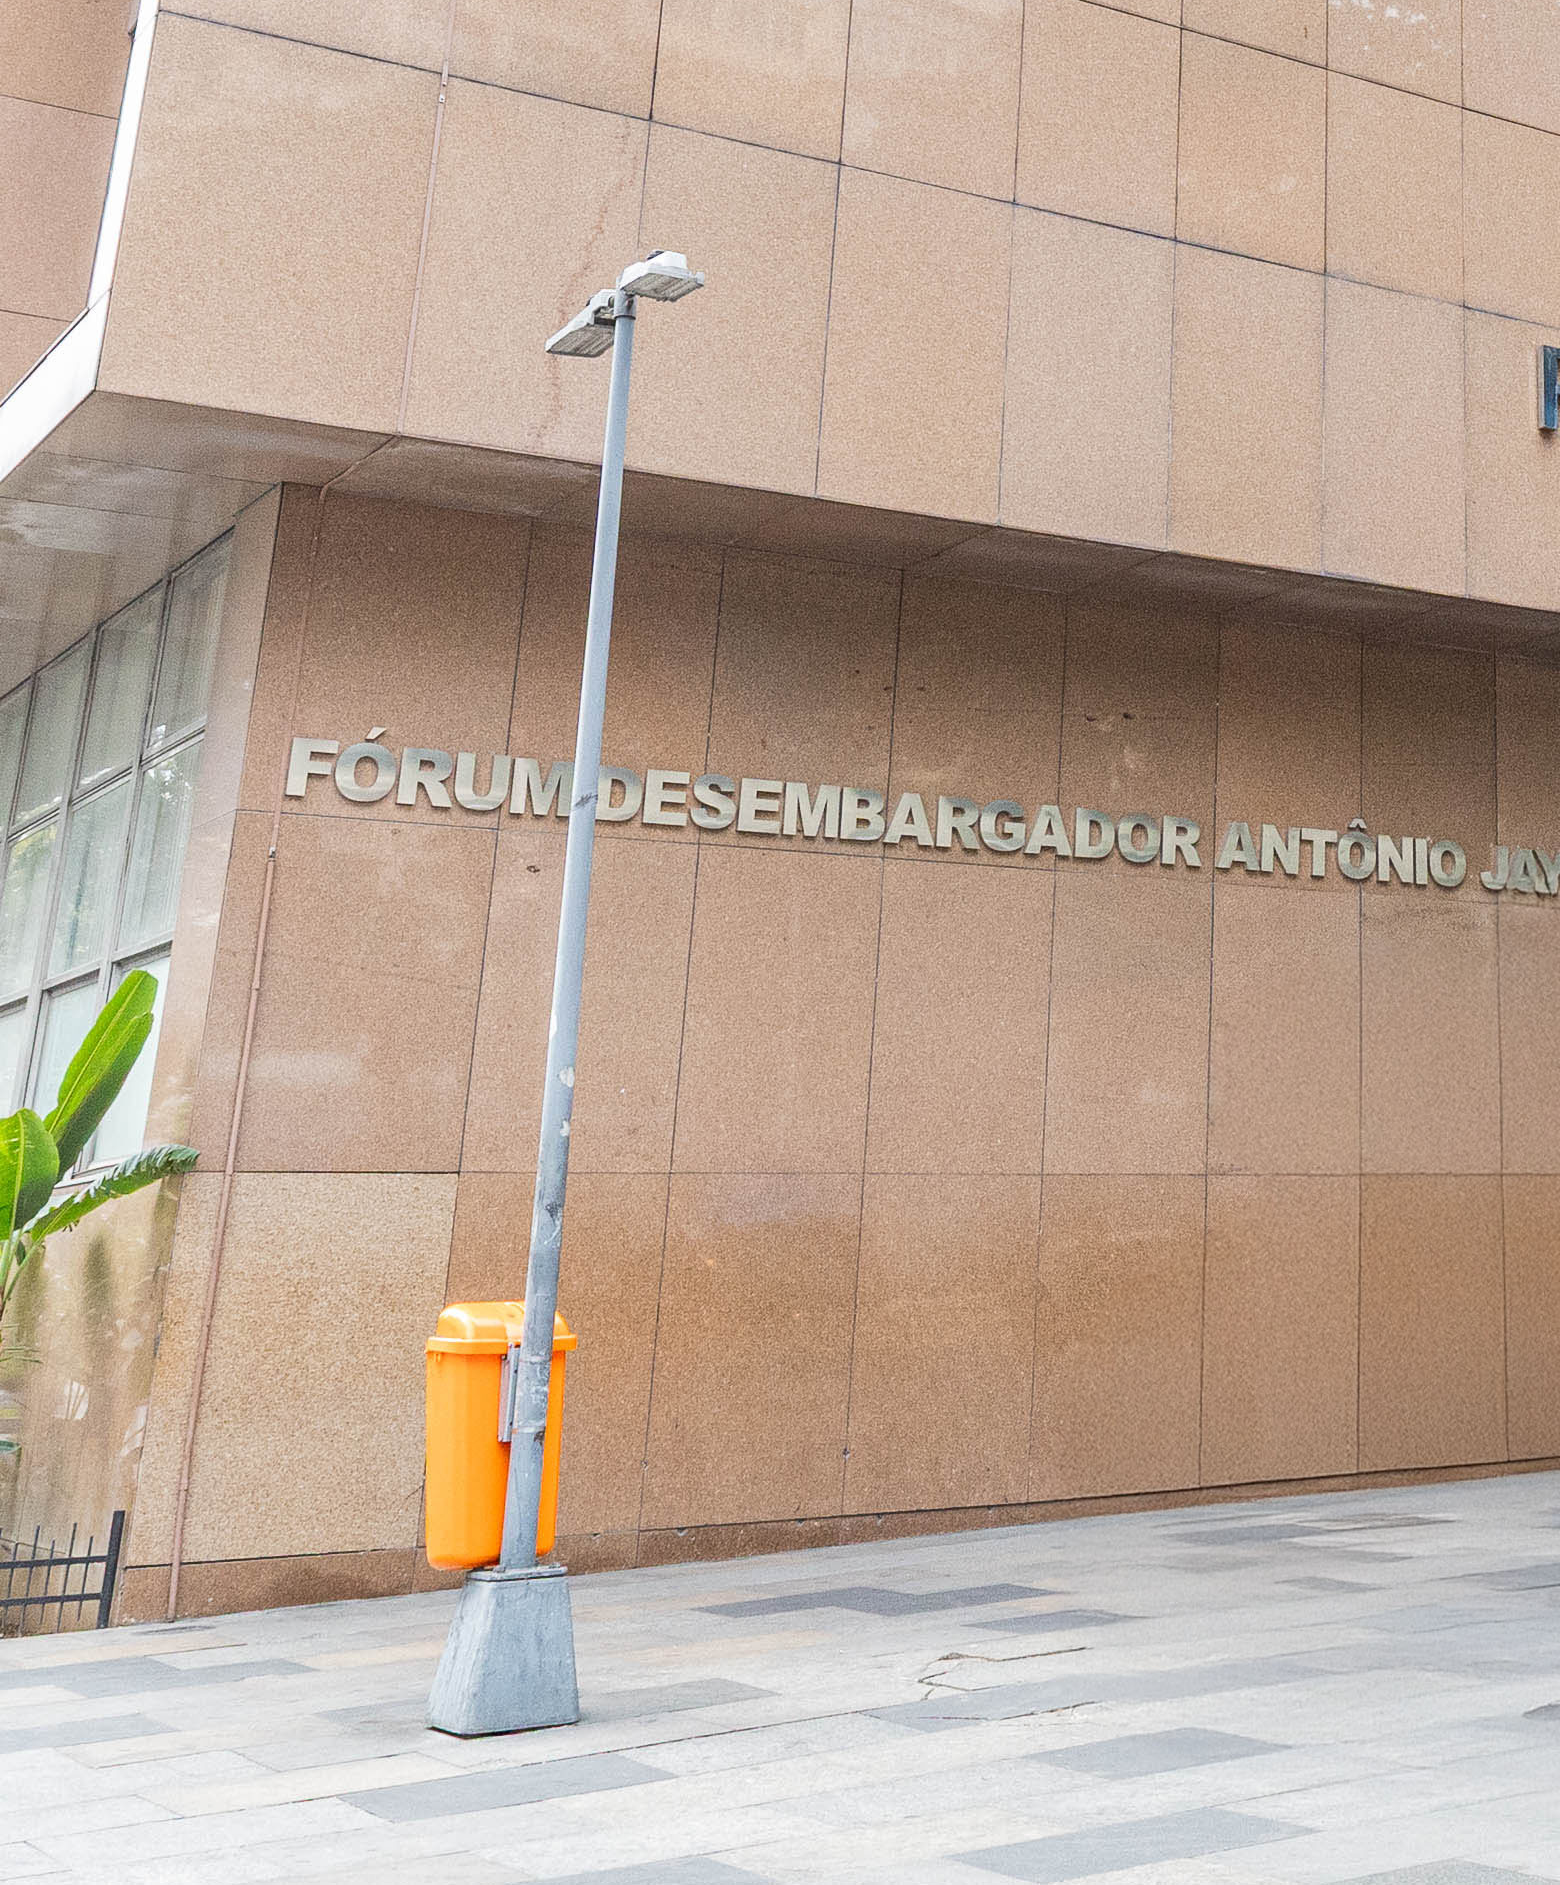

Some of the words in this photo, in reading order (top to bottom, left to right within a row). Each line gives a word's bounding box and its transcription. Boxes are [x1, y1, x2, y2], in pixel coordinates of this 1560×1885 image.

[284, 726, 574, 818] FÓRUM
[594, 765, 1203, 868] DESEMBARGADOR
[1216, 817, 1468, 888] ANTÔNIO
